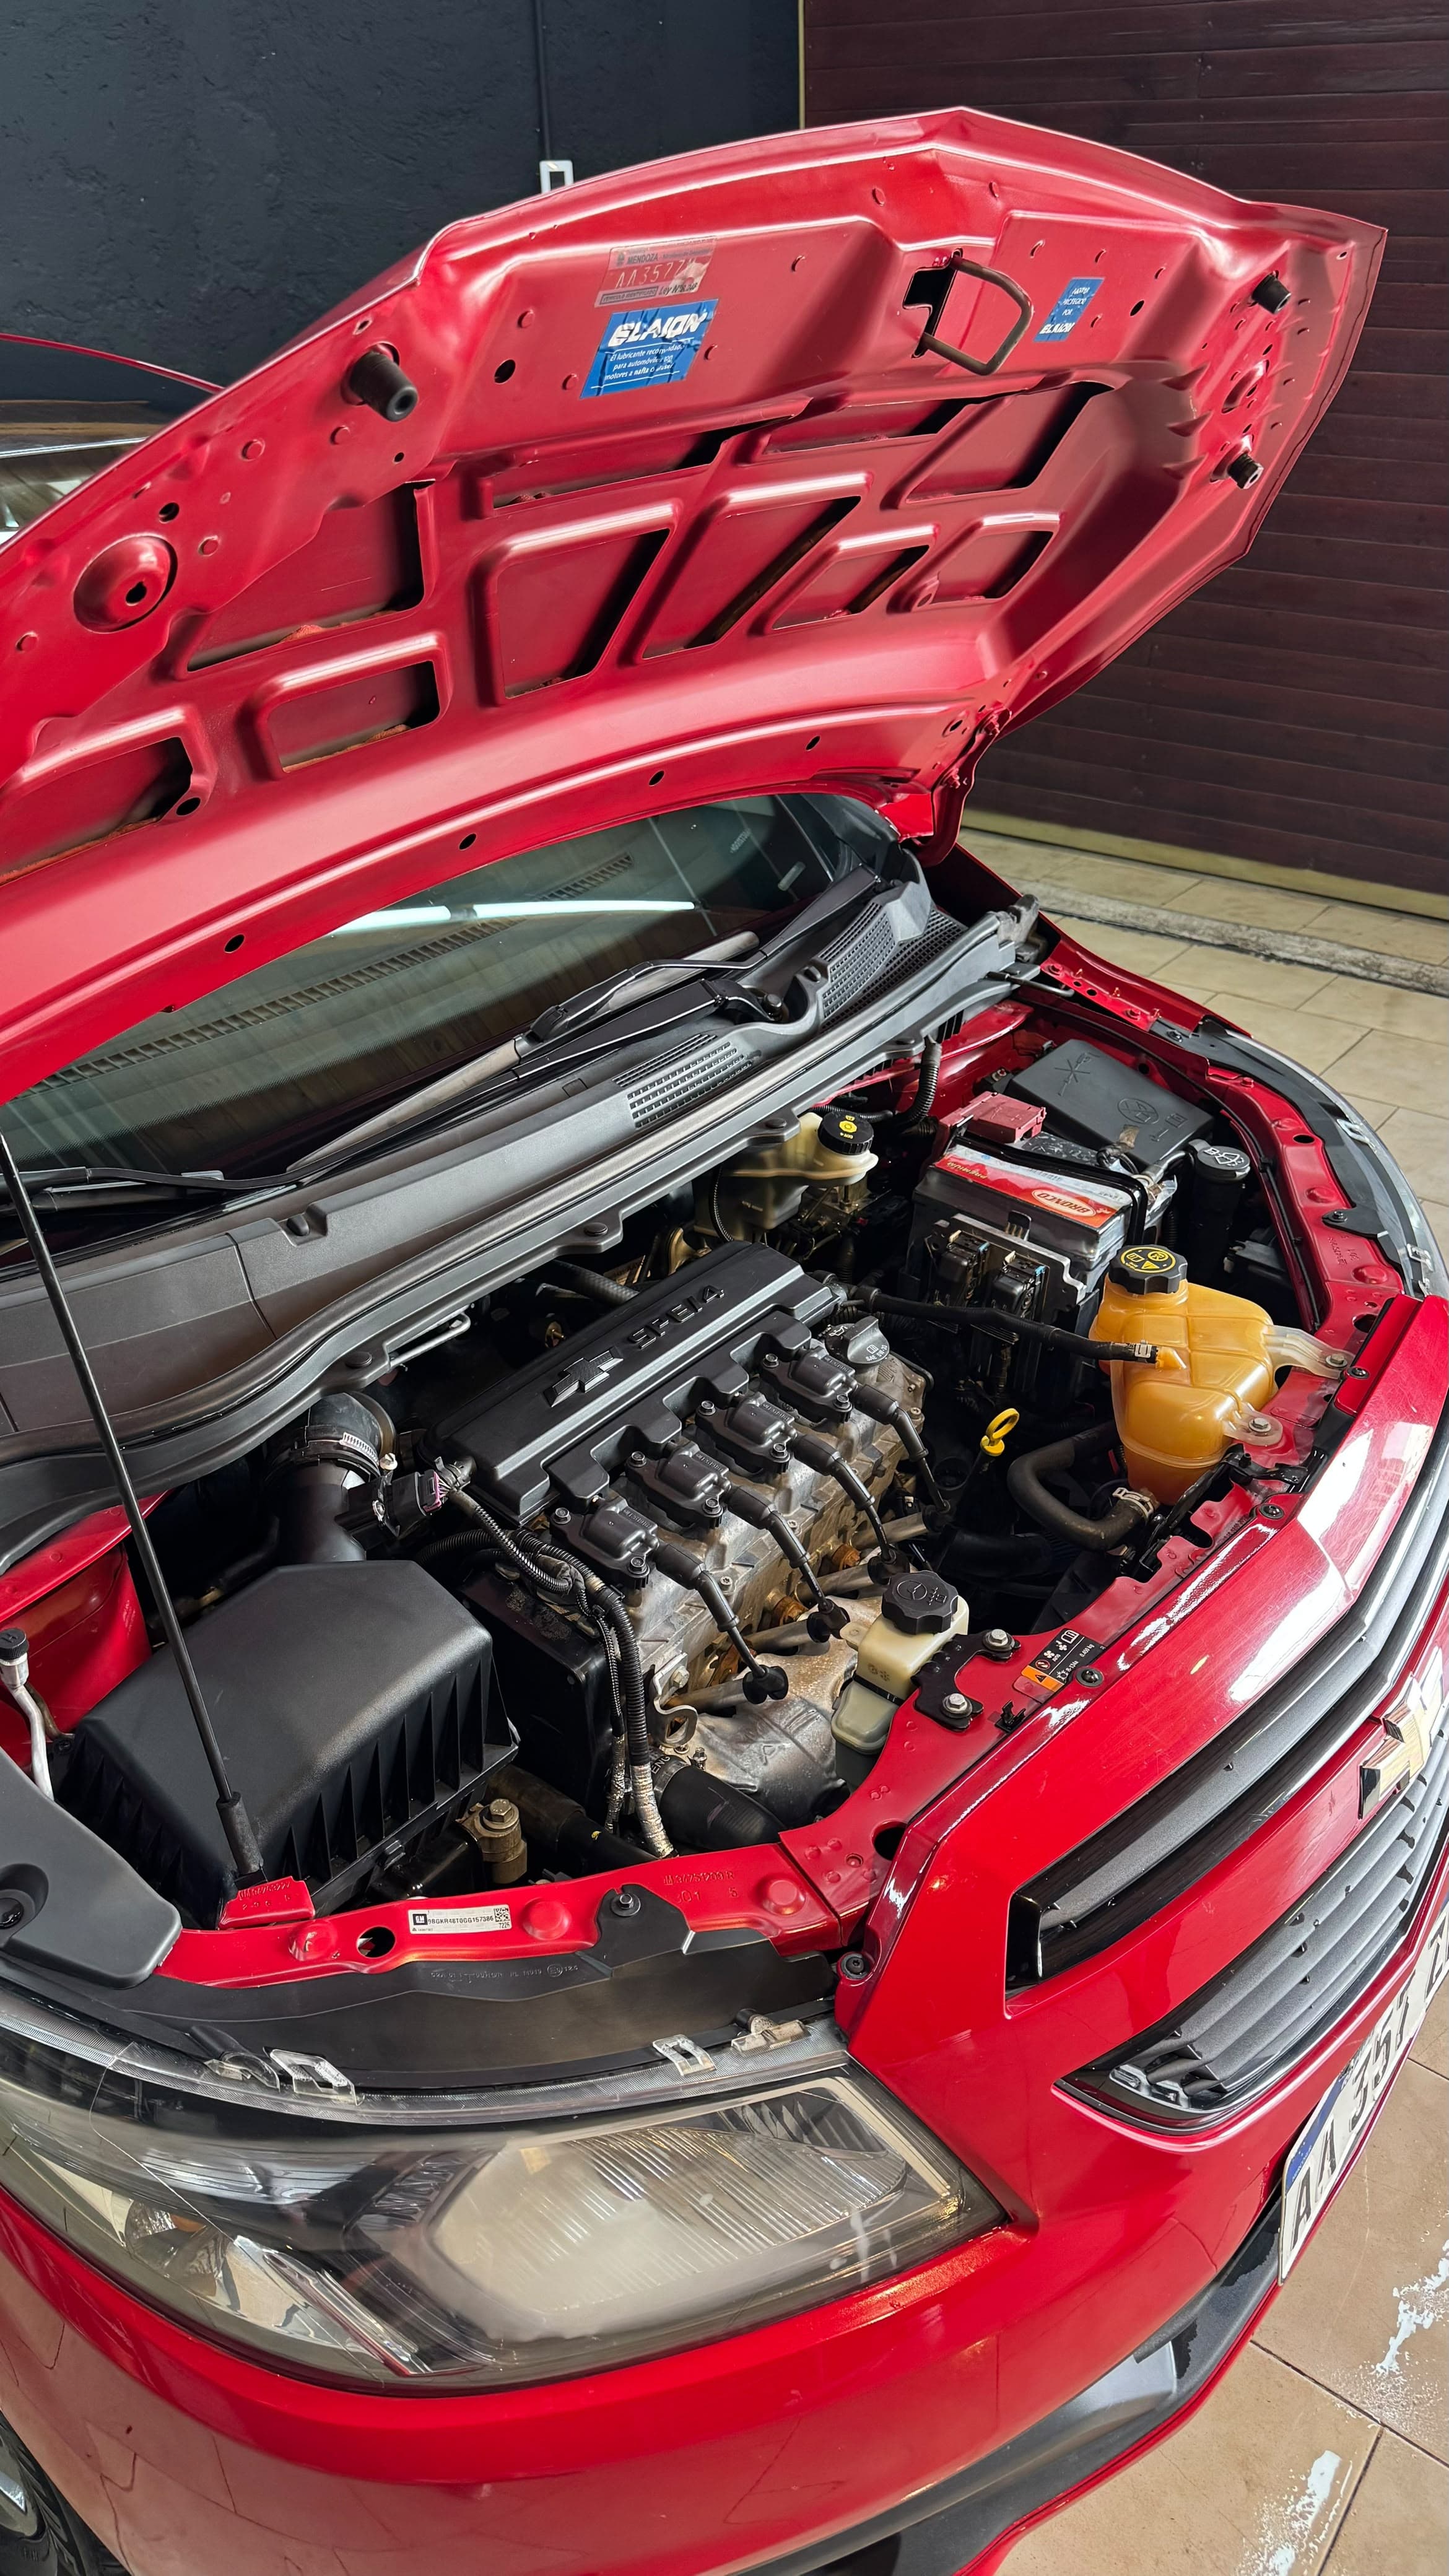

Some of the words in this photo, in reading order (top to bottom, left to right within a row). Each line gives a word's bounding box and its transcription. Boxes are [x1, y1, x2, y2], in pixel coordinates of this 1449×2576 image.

[627, 253, 659, 265] MENDOZA
[607, 311, 709, 347] ELAION
[1039, 322, 1076, 335] ELAION
[617, 350, 646, 360] lubricante
[612, 362, 627, 372] para
[605, 372, 628, 381] motores
[947, 1160, 988, 1180] PREMIUM
[1037, 1191, 1090, 1214] BRONCO
[1292, 2120, 1337, 2250] AA
[1350, 1969, 1417, 2133] 357
